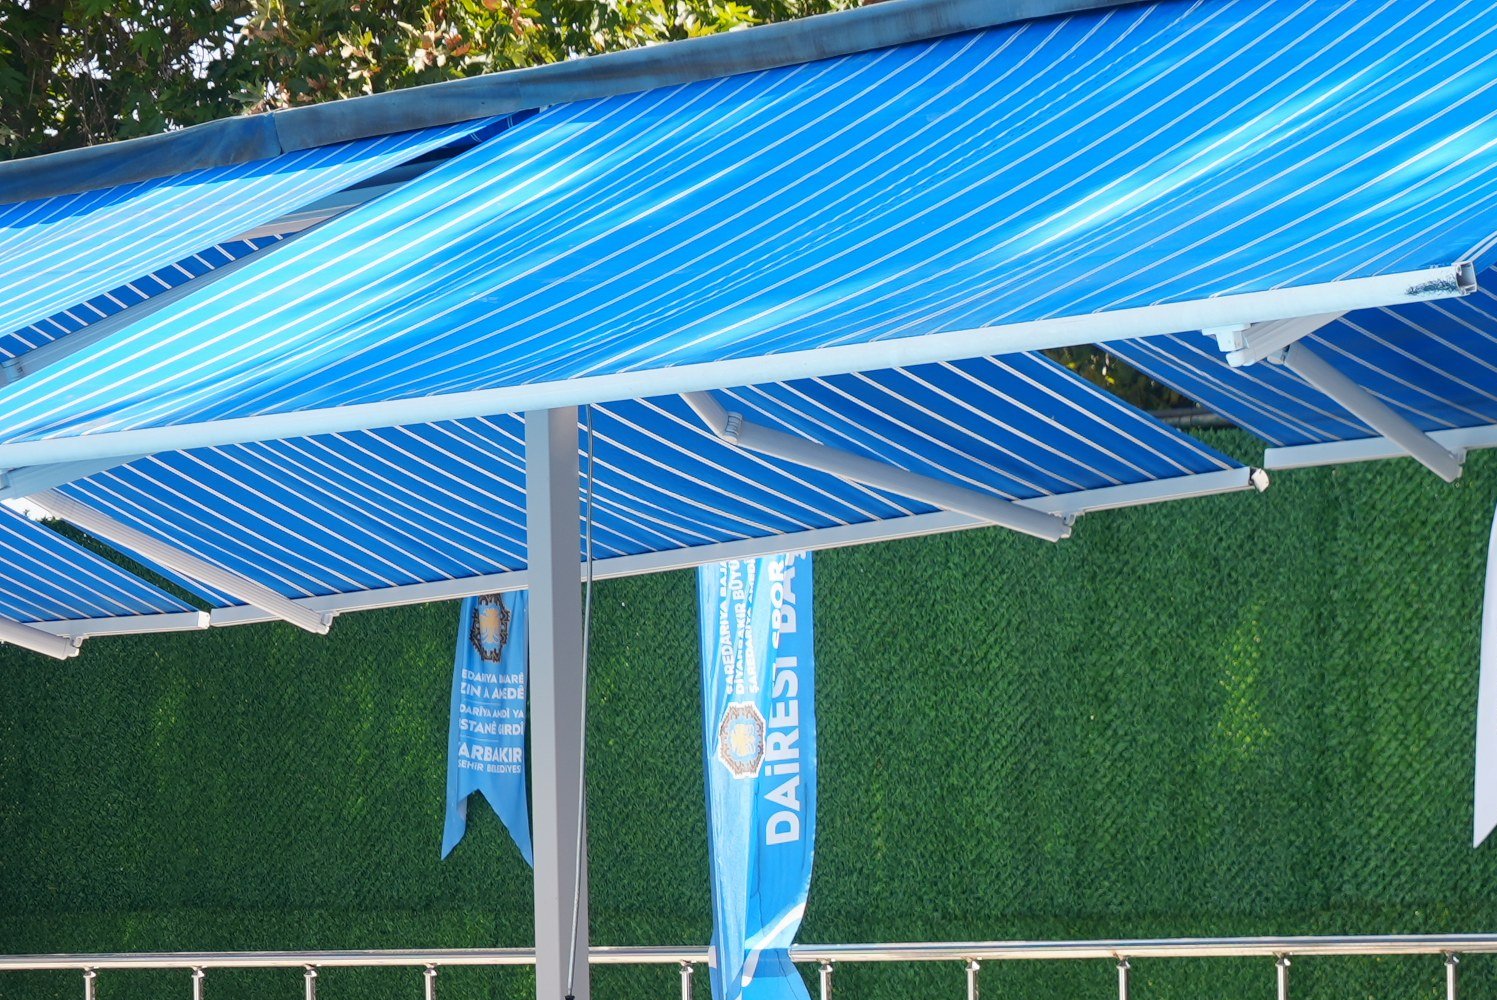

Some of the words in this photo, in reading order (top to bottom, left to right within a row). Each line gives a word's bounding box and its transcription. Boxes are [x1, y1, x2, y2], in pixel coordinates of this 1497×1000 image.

[728, 559, 746, 601] BÜYÜ
[460, 682, 482, 698] ZIN
[458, 742, 523, 763] ARBAKIR
